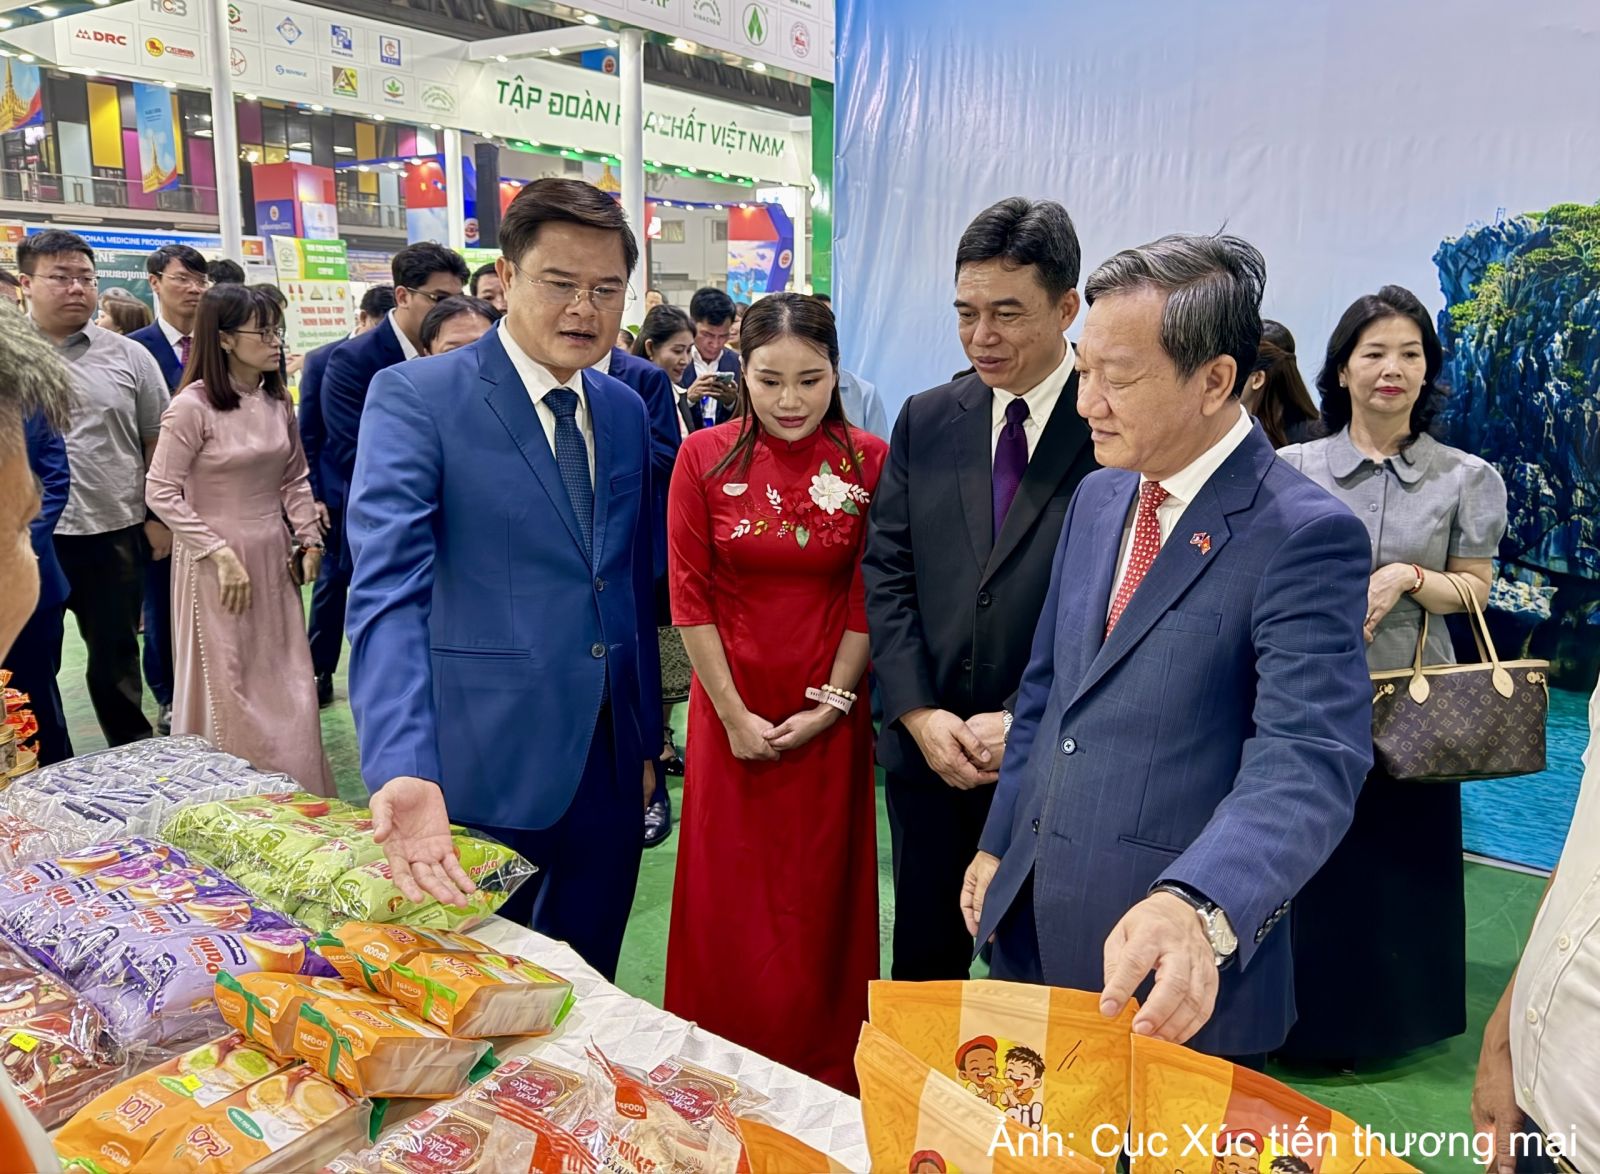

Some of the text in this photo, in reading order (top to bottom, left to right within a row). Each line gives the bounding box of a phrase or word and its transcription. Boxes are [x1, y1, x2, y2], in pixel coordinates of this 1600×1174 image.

[93, 30, 127, 46] DRC
[497, 75, 542, 114] TẬP
[548, 89, 610, 124] ĐOÀN
[711, 121, 747, 155] VIỆT
[749, 133, 785, 157] NAM
[106, 236, 140, 246] MEDICINE
[510, 1078, 539, 1095] Cake
[423, 1136, 453, 1155] Cake
